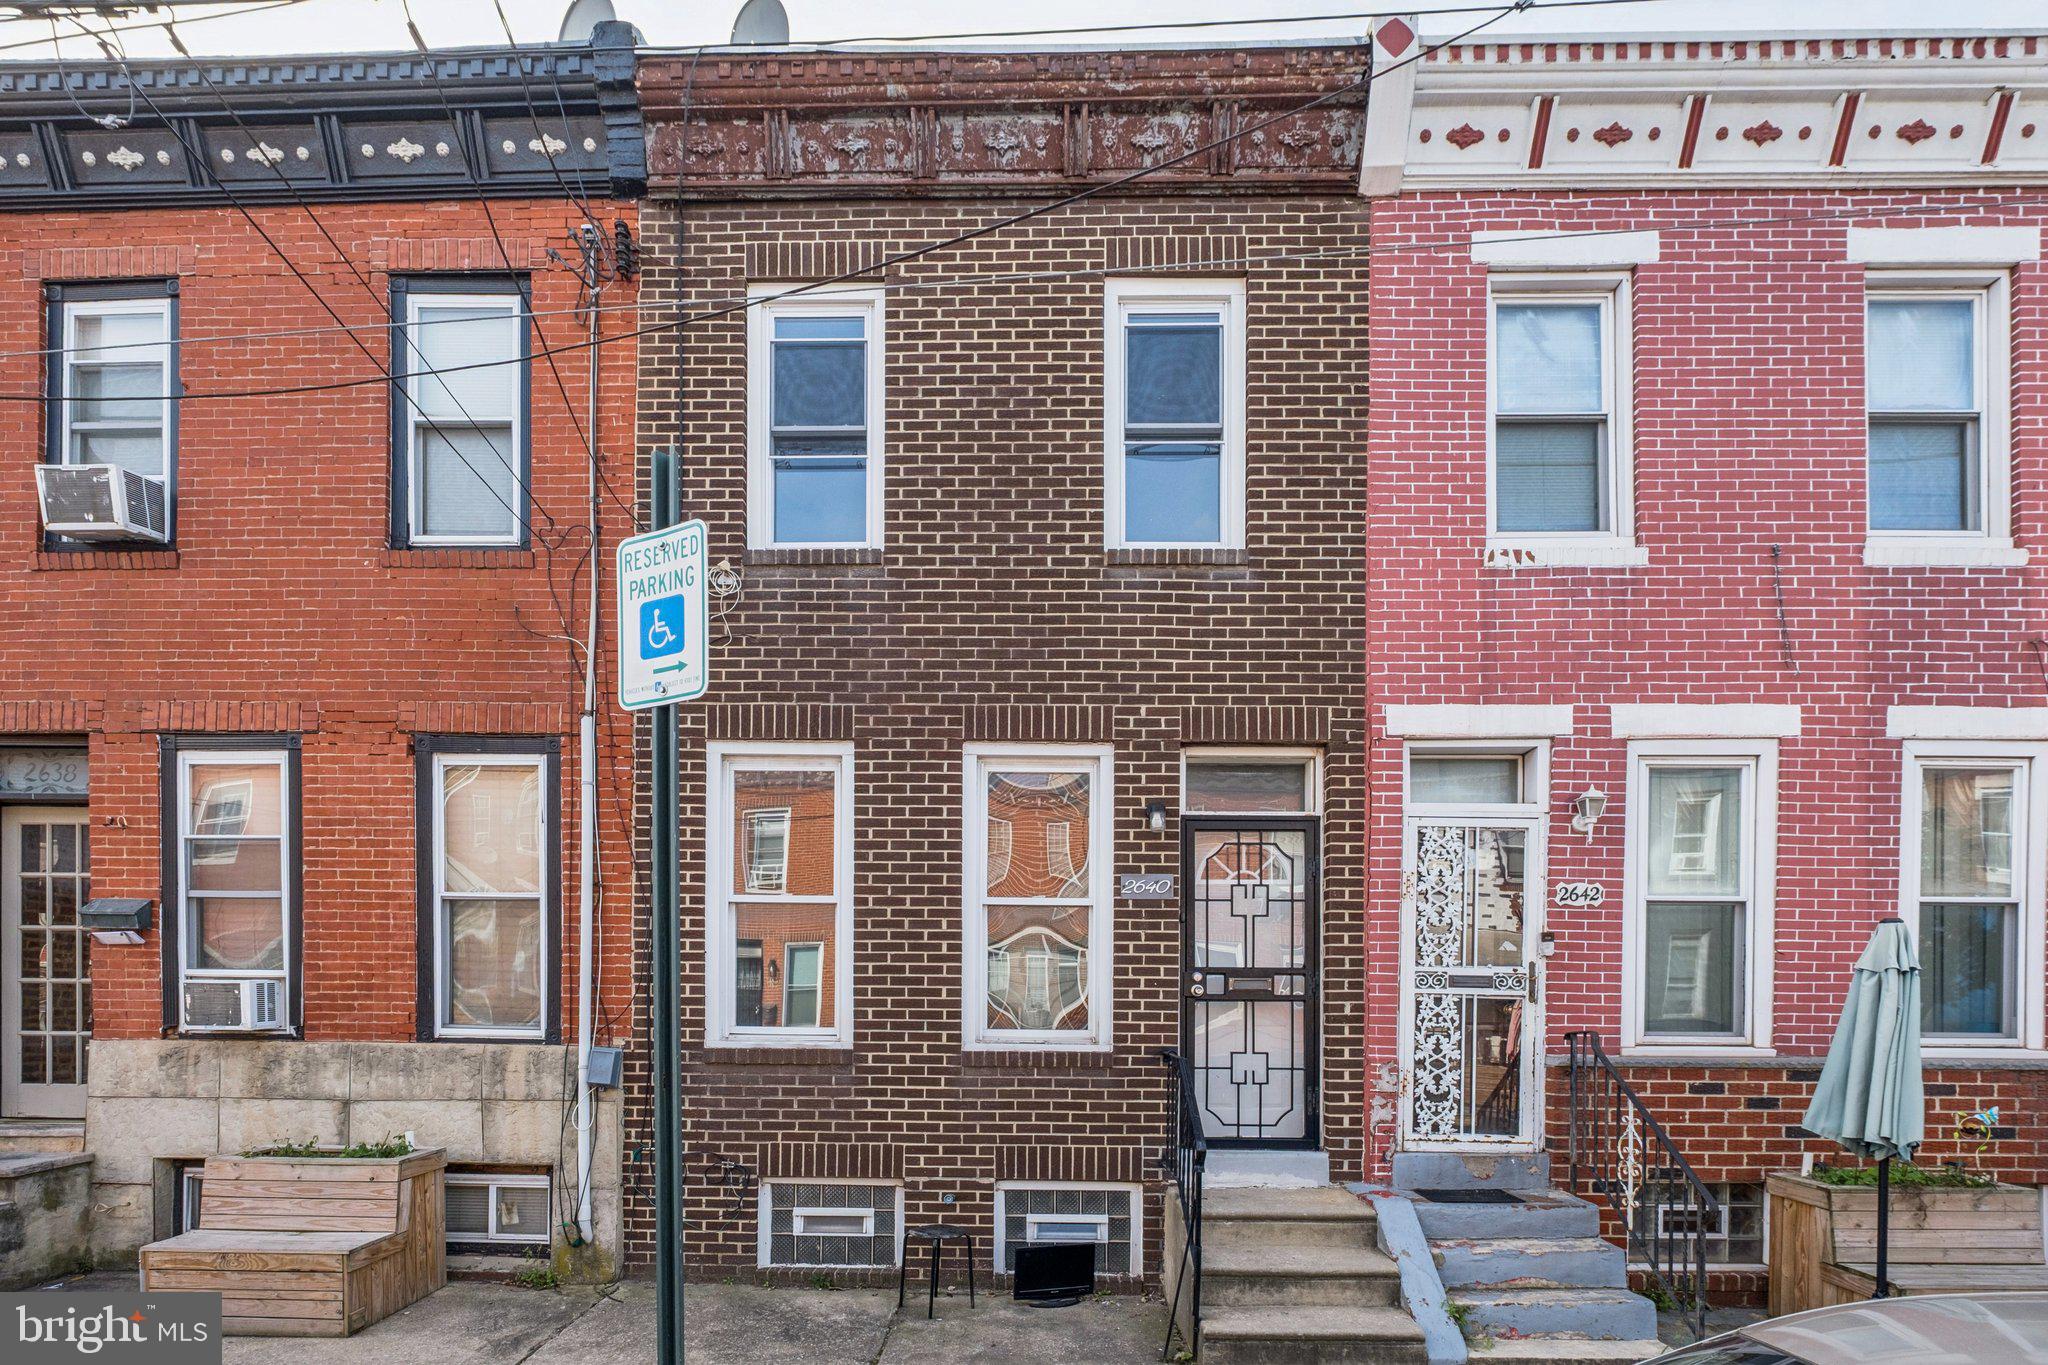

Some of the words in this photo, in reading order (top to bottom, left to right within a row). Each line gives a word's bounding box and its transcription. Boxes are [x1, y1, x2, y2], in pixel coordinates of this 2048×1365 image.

[624, 534, 699, 573] RESERVED
[629, 565, 695, 601] PARKING
[23, 762, 78, 783] 2638
[1121, 879, 1171, 894] 2640
[1559, 885, 1600, 902] 2642
